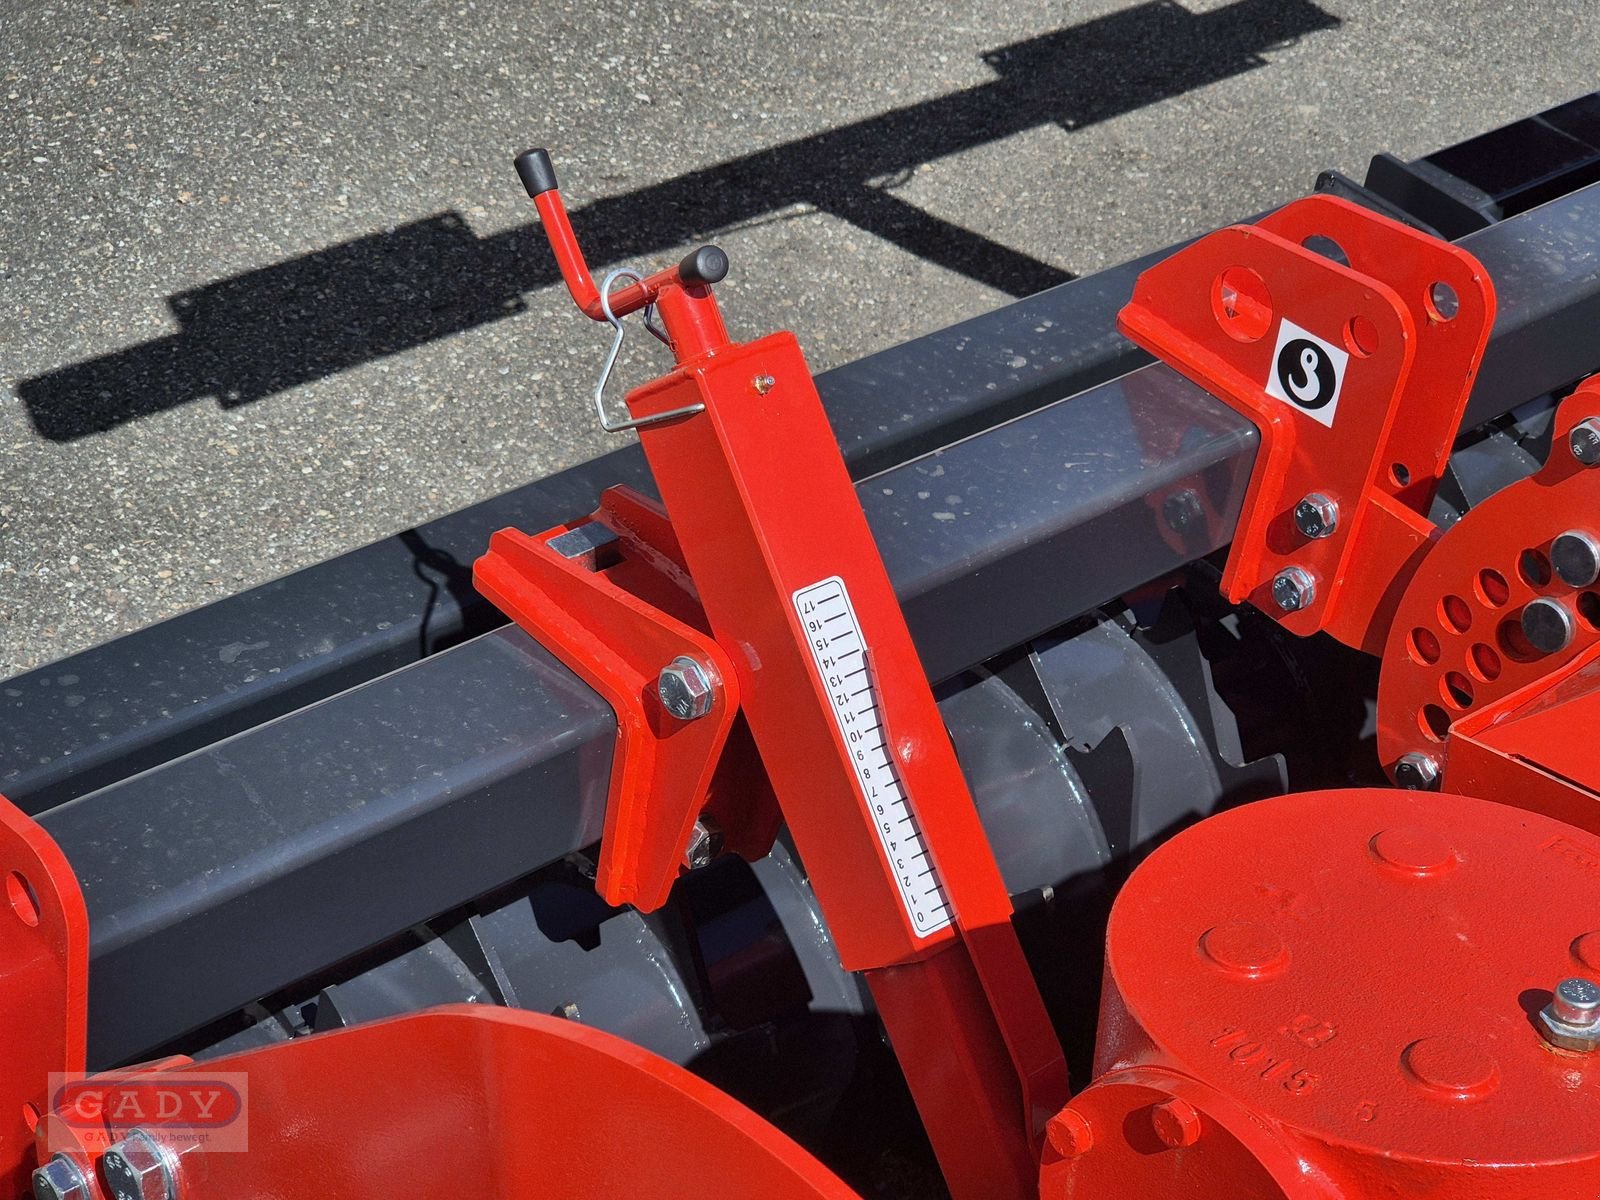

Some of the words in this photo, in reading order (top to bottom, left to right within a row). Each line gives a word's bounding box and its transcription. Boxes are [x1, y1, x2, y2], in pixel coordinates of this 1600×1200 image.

[804, 601, 815, 614] 17
[809, 620, 822, 632] 16
[816, 638, 829, 651] 15
[823, 656, 836, 669] 14
[830, 675, 842, 687] 13
[836, 693, 849, 706] 12
[844, 712, 855, 724] 11
[850, 730, 862, 742] 10
[857, 751, 864, 760] 9
[864, 768, 870, 779] 8
[872, 787, 878, 797] 7
[877, 805, 884, 815] 6
[884, 823, 890, 834] 5
[890, 842, 896, 852] 4
[897, 859, 904, 869] 3
[904, 876, 911, 887] 2
[911, 895, 917, 904] 1
[917, 912, 924, 922] 0
